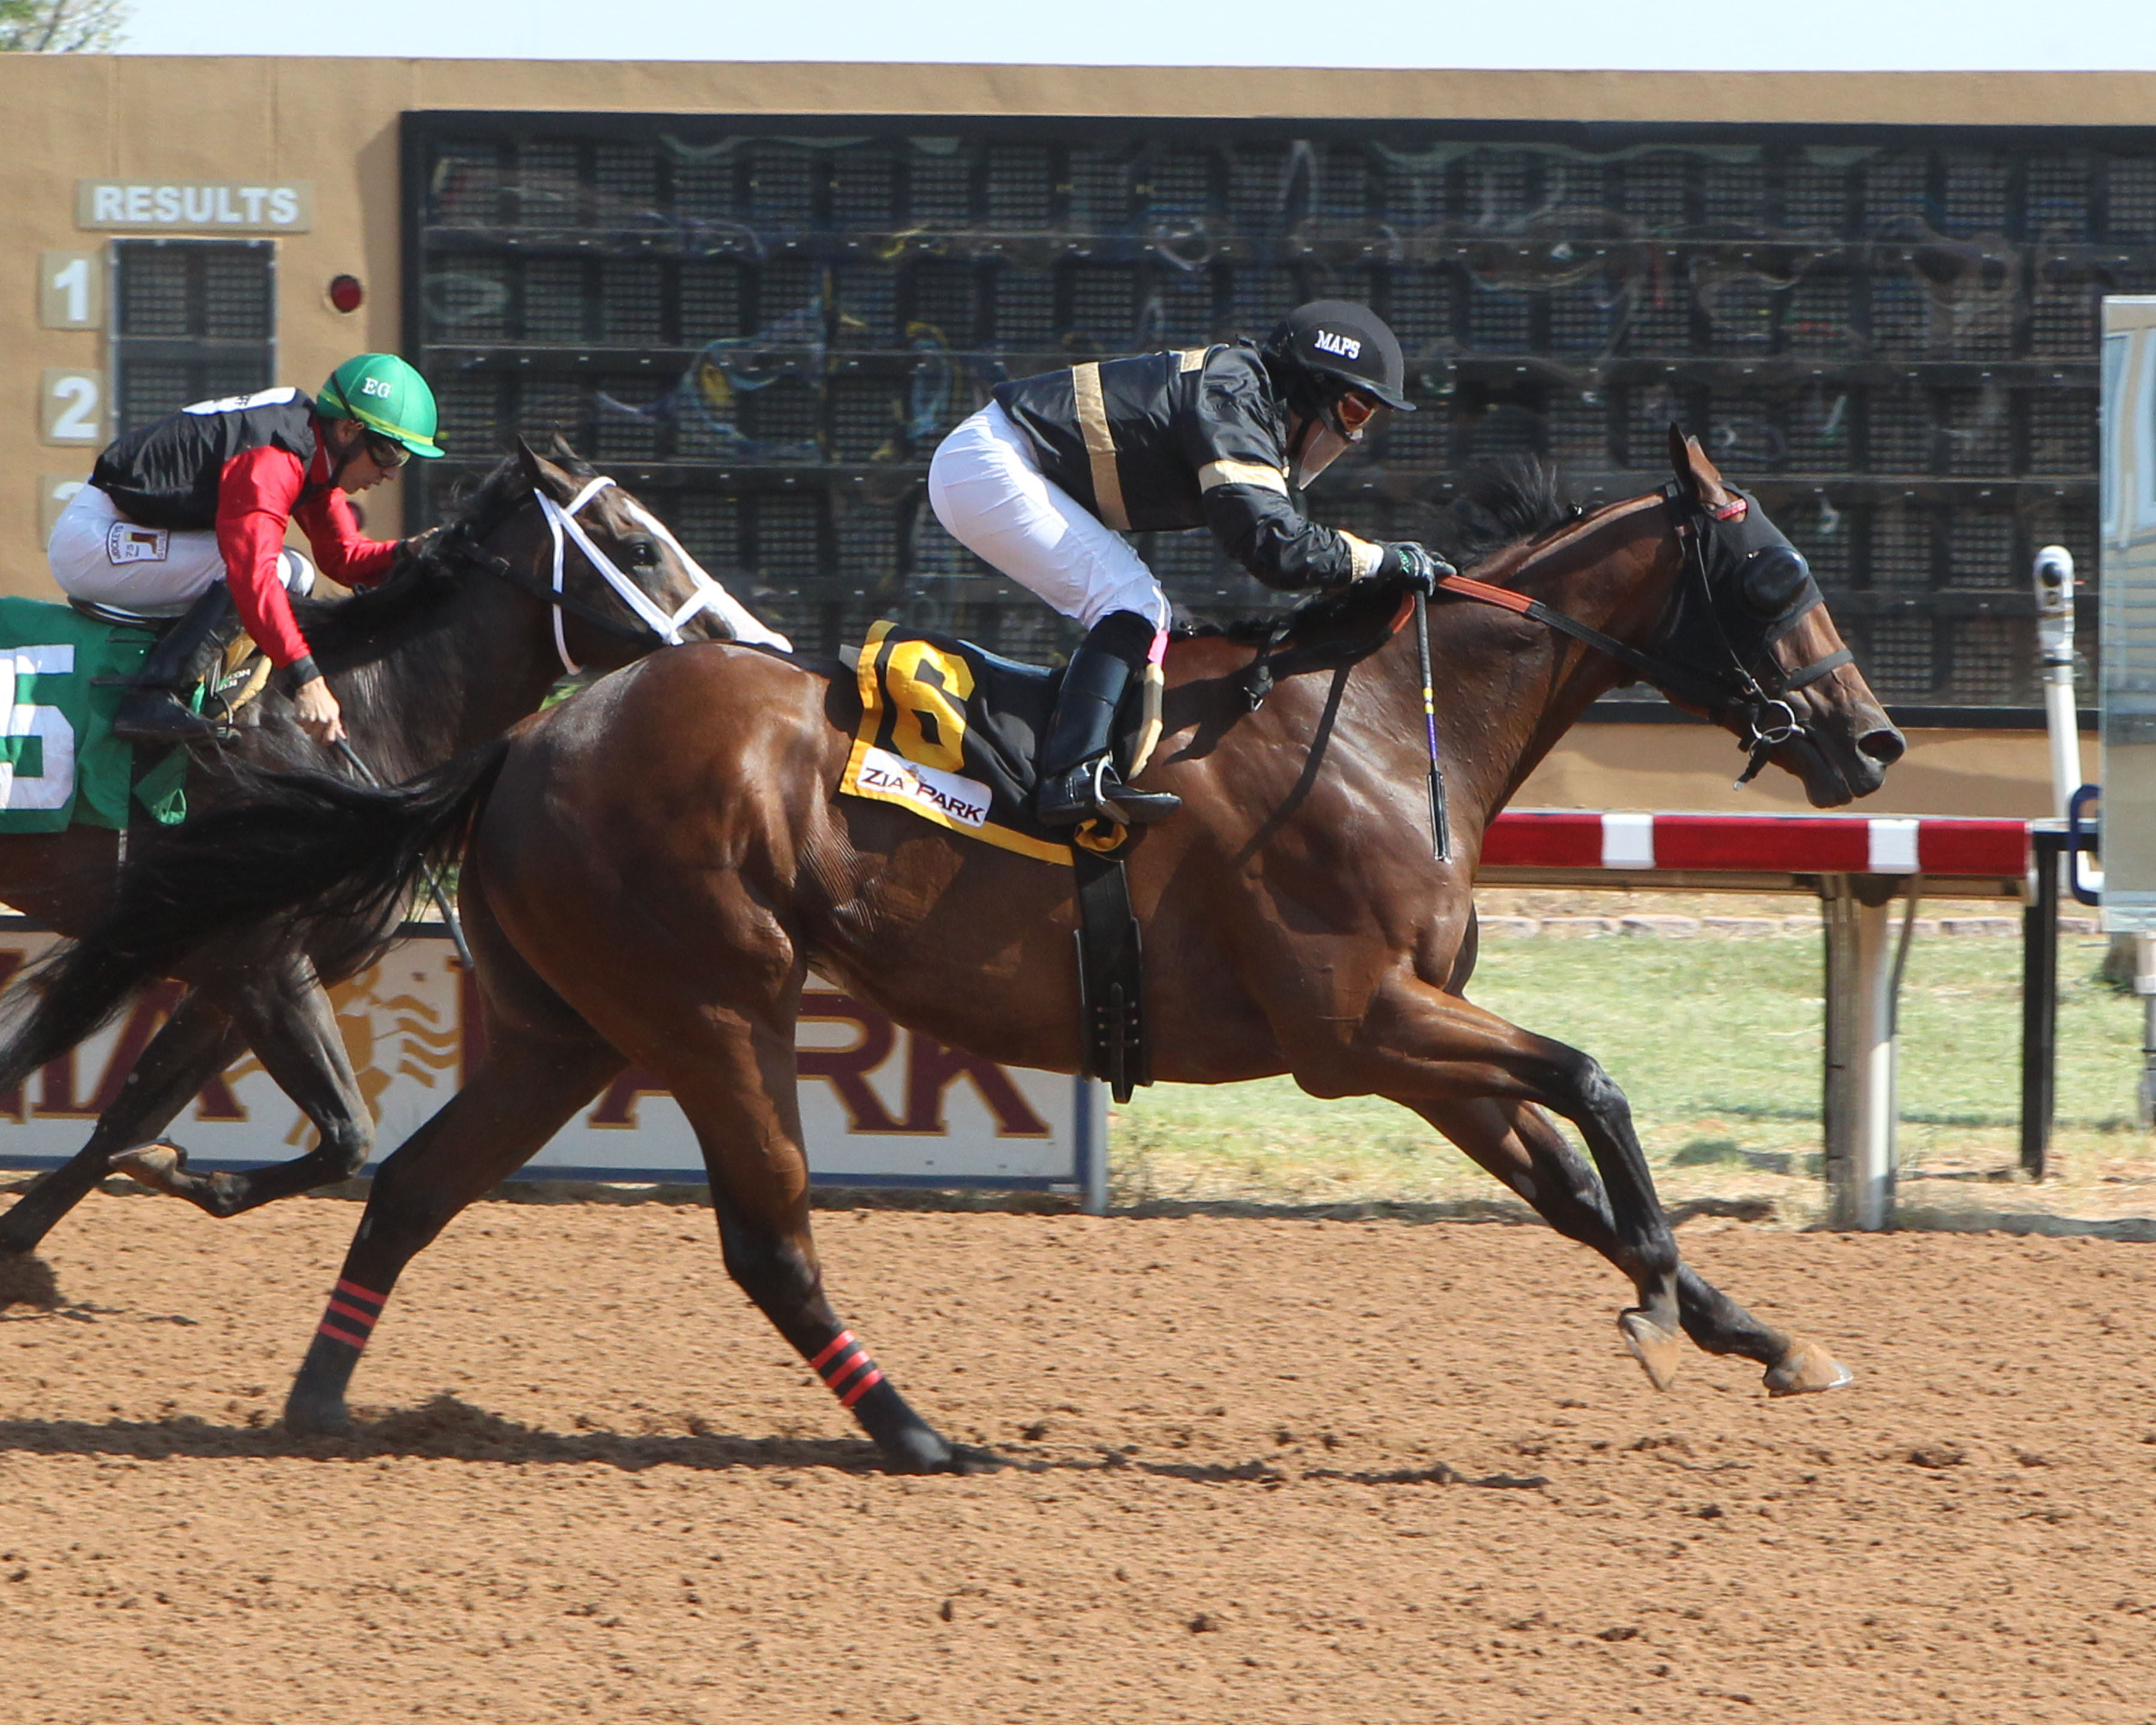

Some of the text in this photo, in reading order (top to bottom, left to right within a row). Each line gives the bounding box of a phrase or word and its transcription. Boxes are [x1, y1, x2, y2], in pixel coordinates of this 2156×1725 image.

[94, 186, 299, 224] RESULTS
[54, 259, 88, 322] 1
[1314, 329, 1361, 359] MAPS
[52, 376, 99, 438] 2
[362, 377, 390, 398] EG
[0, 644, 74, 810] 5
[886, 640, 975, 773] 6
[861, 766, 985, 823] ZIA PARK
